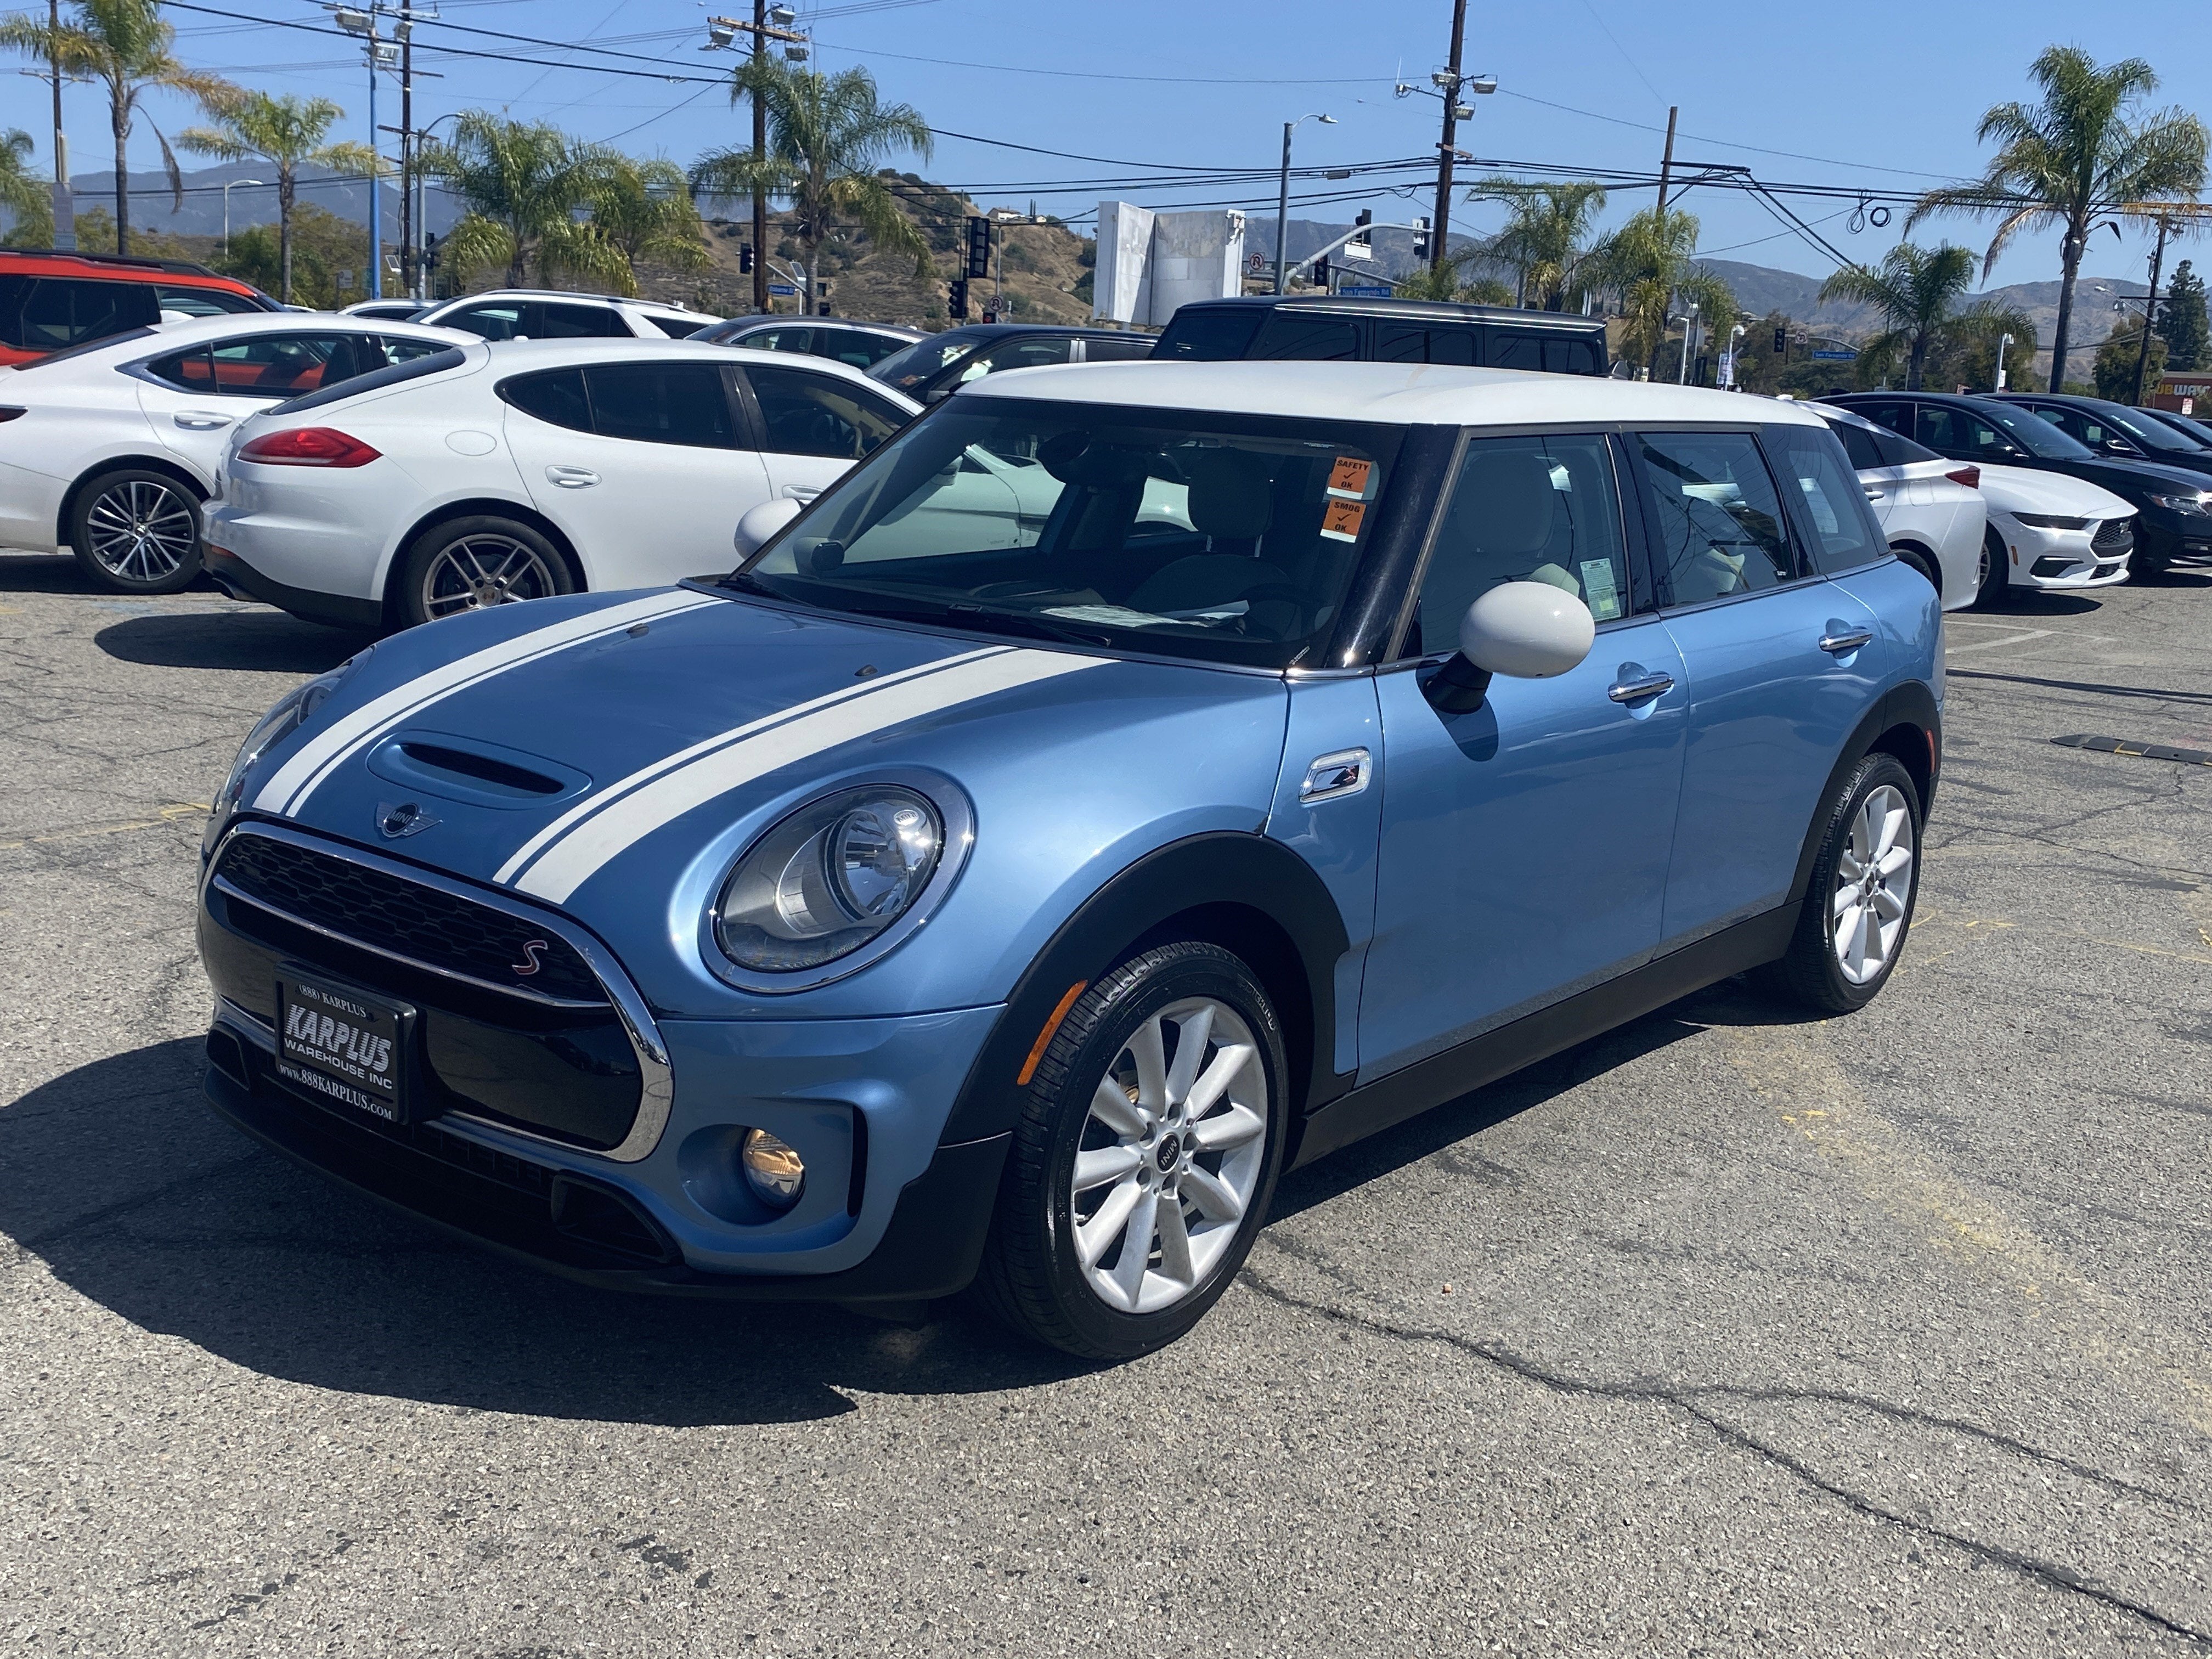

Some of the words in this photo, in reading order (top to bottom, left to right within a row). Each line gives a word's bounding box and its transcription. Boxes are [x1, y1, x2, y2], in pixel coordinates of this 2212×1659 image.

[2155, 384, 2211, 396] UBWAY
[1336, 460, 1369, 471] SAFETY
[1334, 501, 1361, 512] SMOG
[388, 810, 413, 824] MINI
[511, 940, 548, 975] S
[298, 984, 320, 1001] (888)
[322, 992, 366, 1018] KARPLUS
[285, 1003, 392, 1073] KARPLUS
[284, 1037, 365, 1079] WAREHOUSE
[369, 1072, 392, 1090] INC
[1160, 1139, 1177, 1166] MINI
